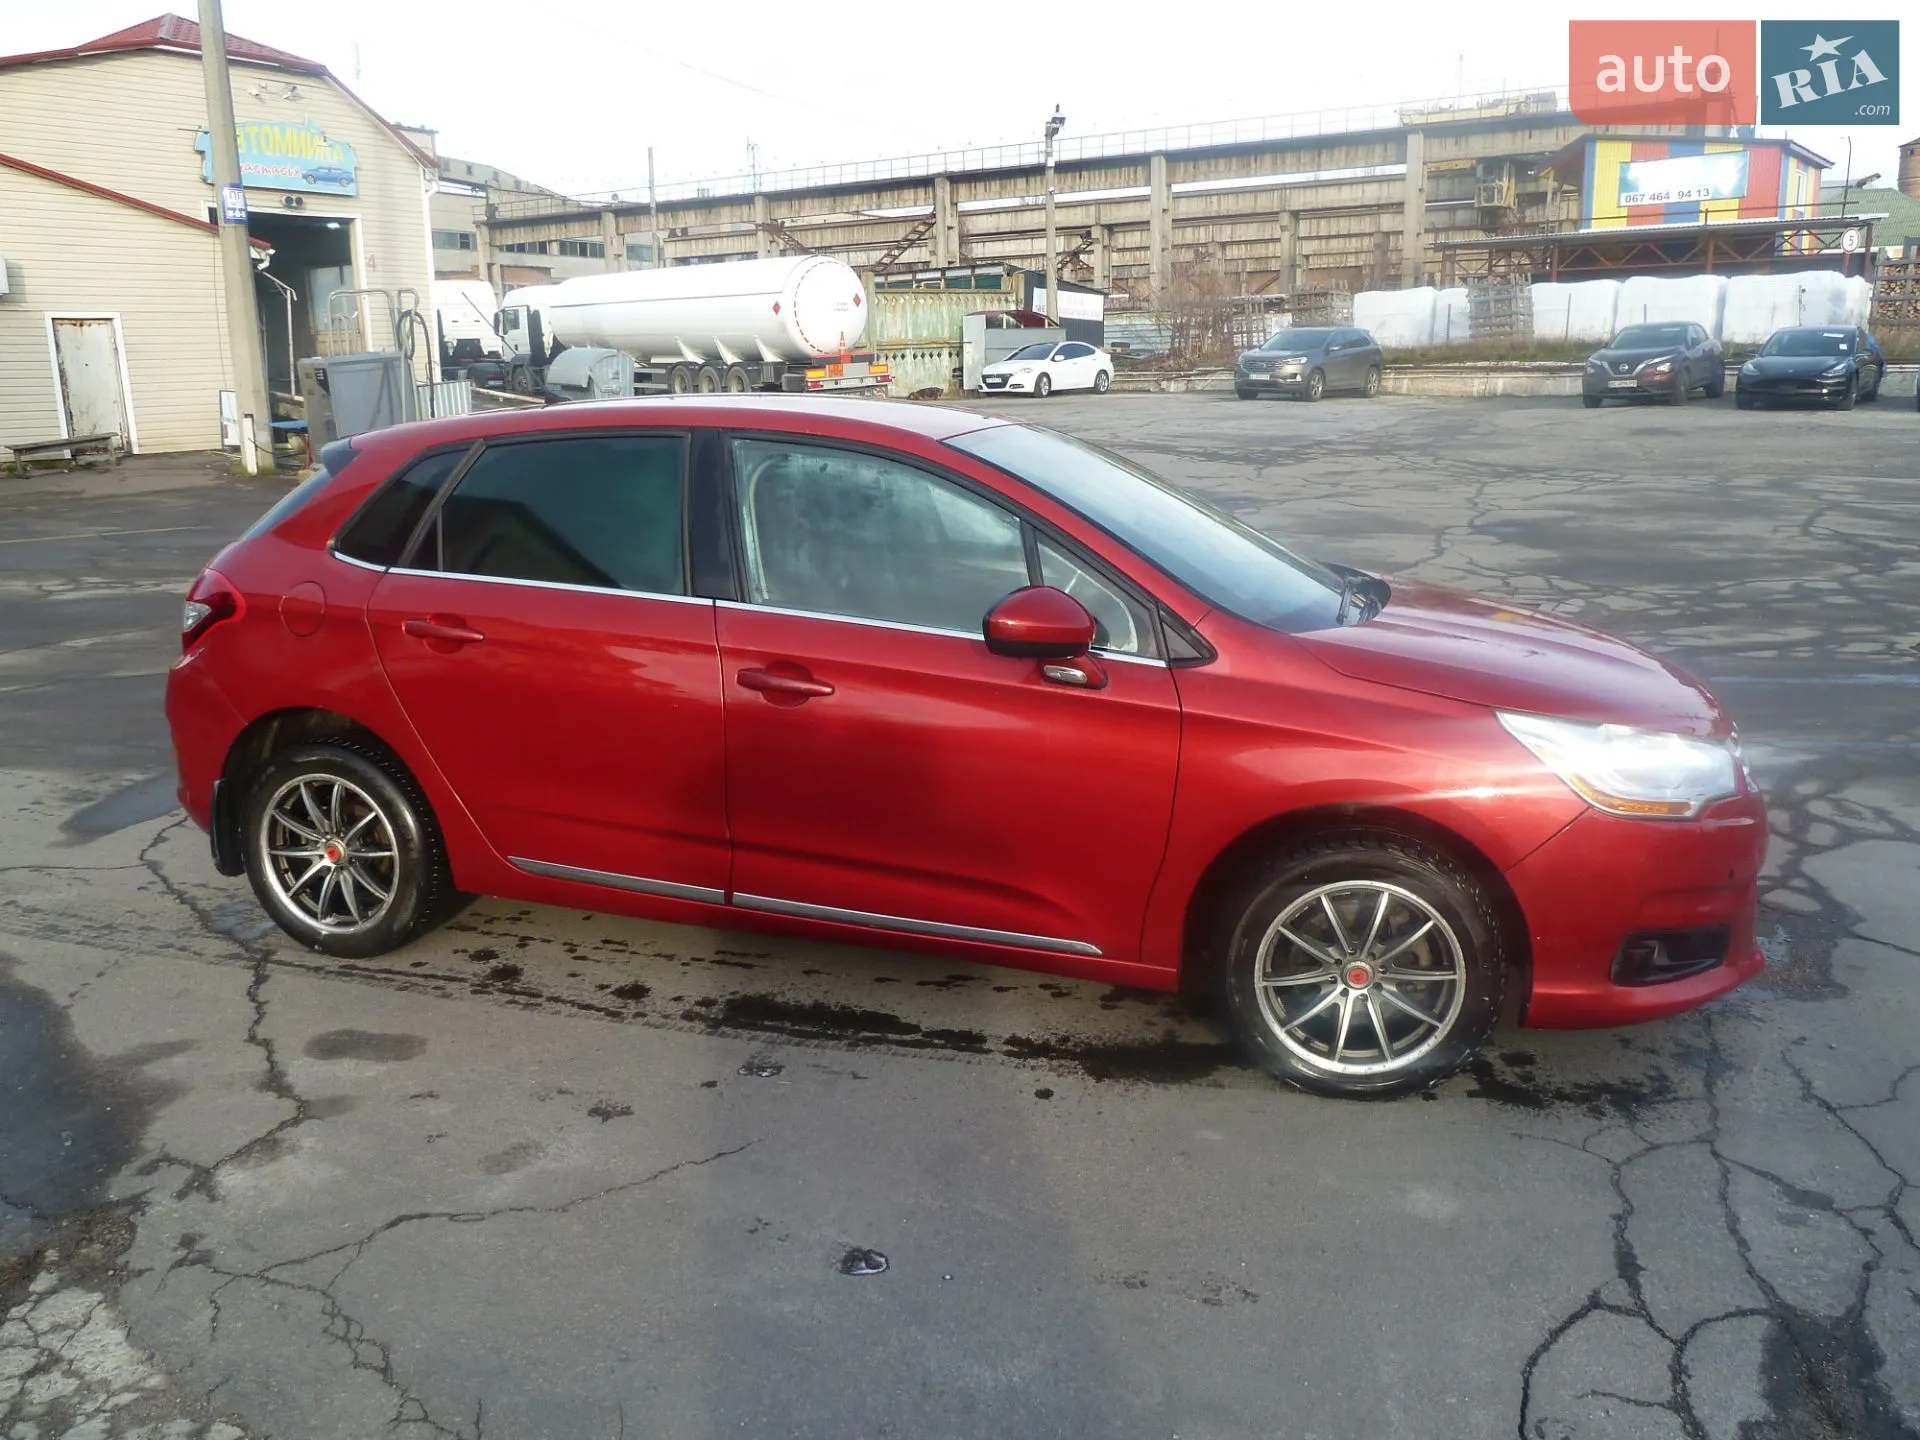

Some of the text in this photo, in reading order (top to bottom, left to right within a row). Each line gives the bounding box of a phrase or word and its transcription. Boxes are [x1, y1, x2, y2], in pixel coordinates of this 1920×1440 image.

[1625, 187, 1710, 203] 067 464 94 13
